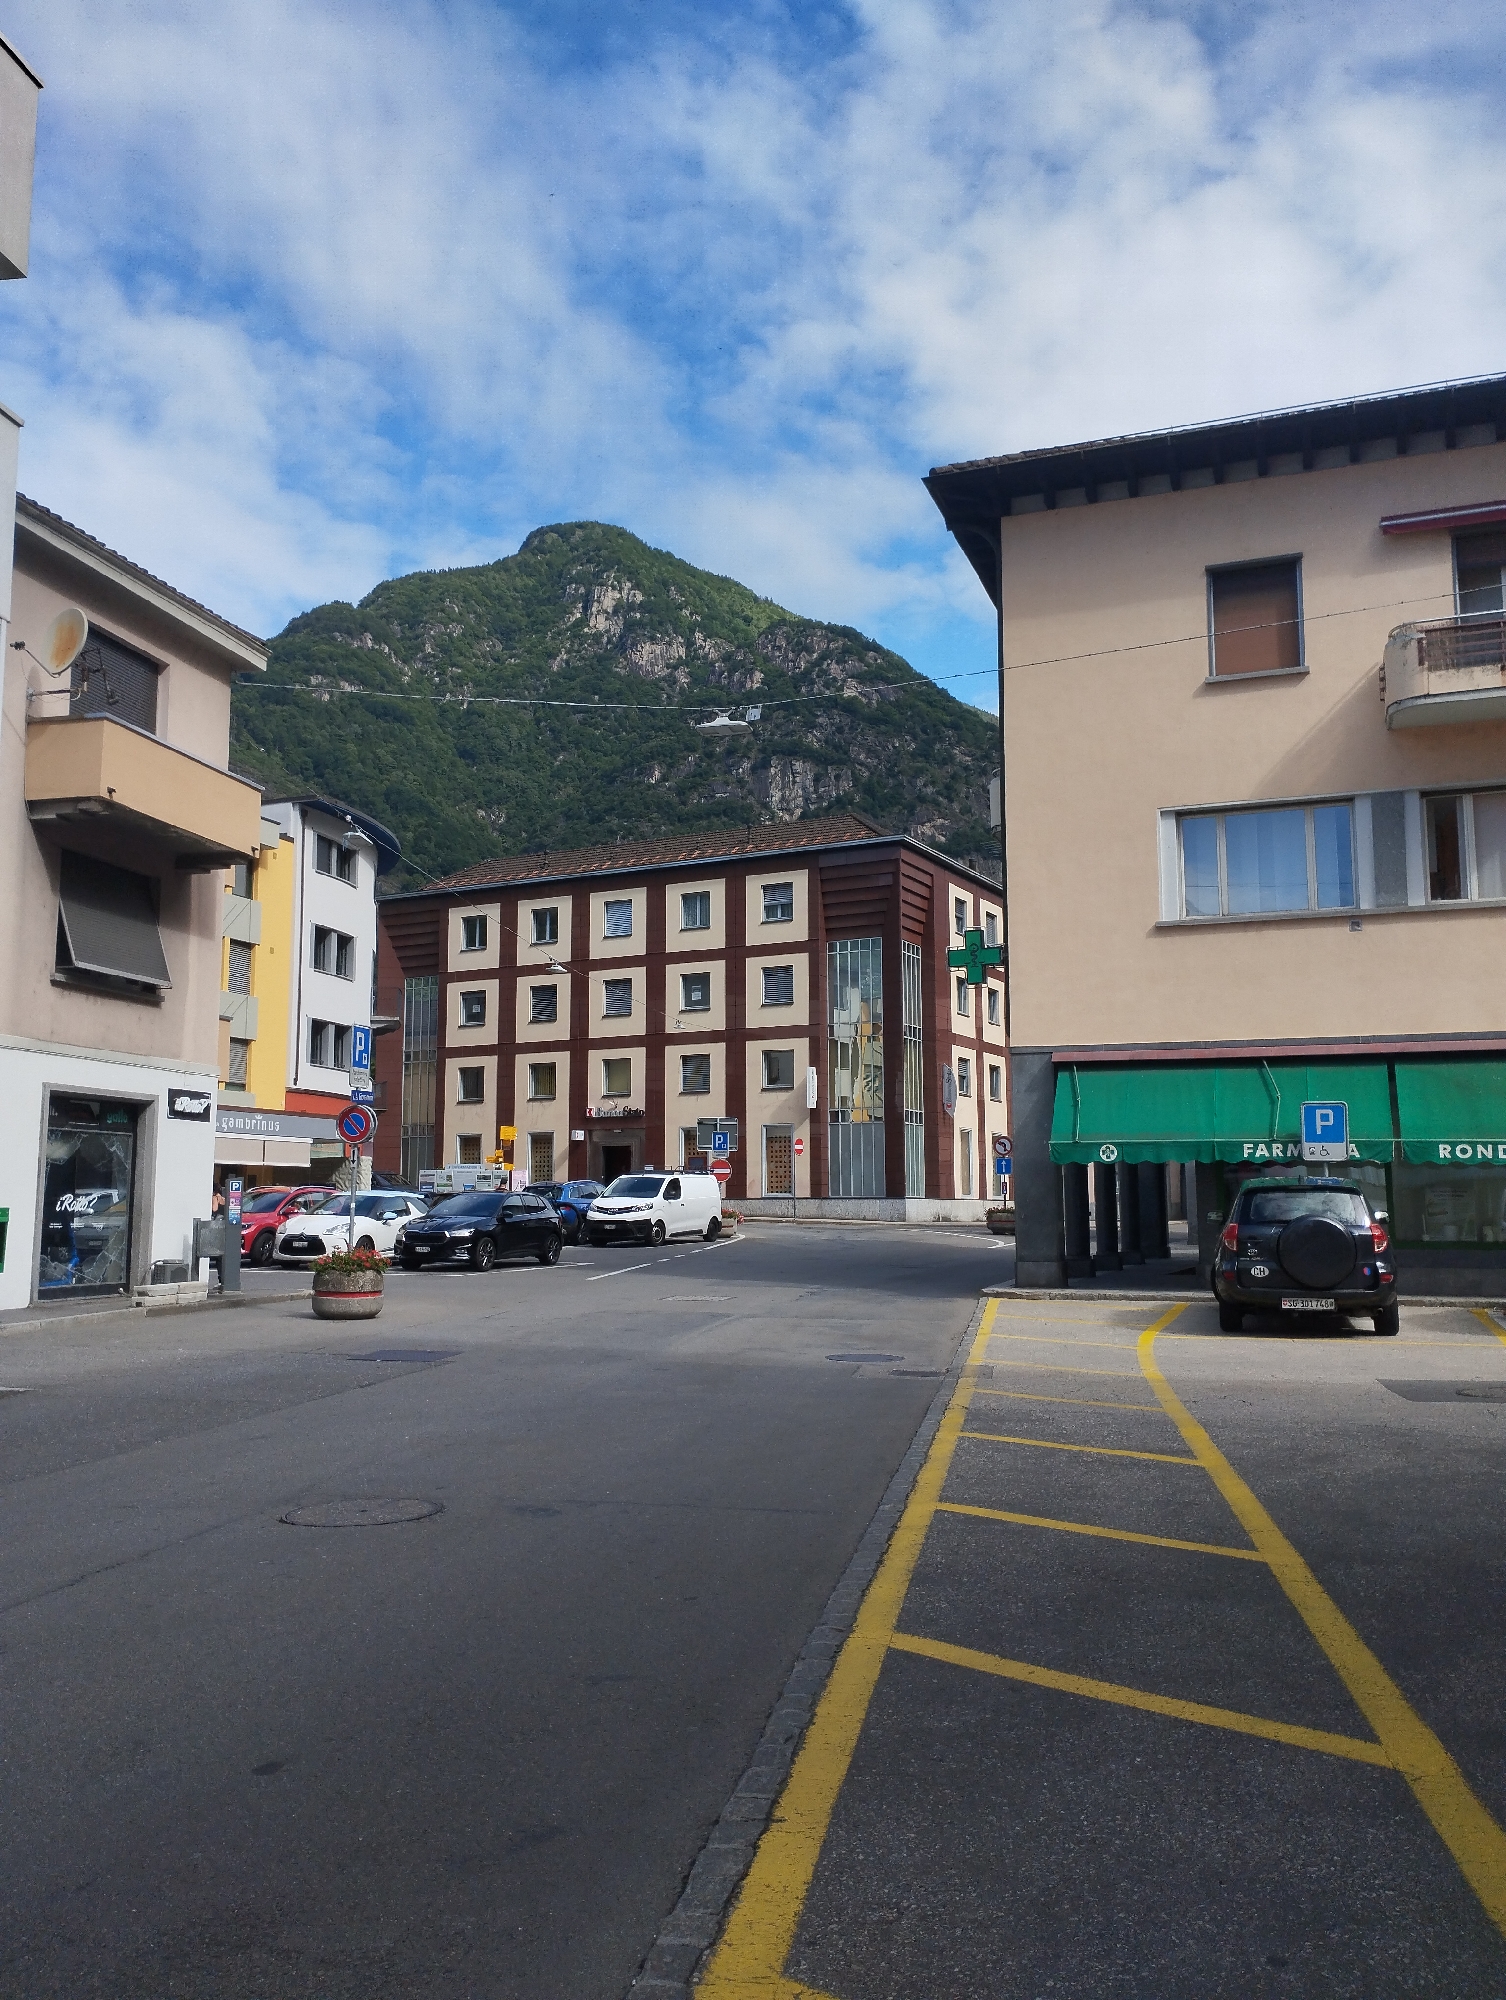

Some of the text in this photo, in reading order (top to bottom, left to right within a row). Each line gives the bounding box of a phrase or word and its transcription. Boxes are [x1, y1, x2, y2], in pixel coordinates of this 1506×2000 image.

[355, 1031, 365, 1062] P
[222, 1117, 280, 1131] gambrinus
[1315, 1109, 1334, 1135] P
[715, 1134, 724, 1149] P
[1243, 1143, 1361, 1158] FARMA
[1253, 1267, 1266, 1277] CH
